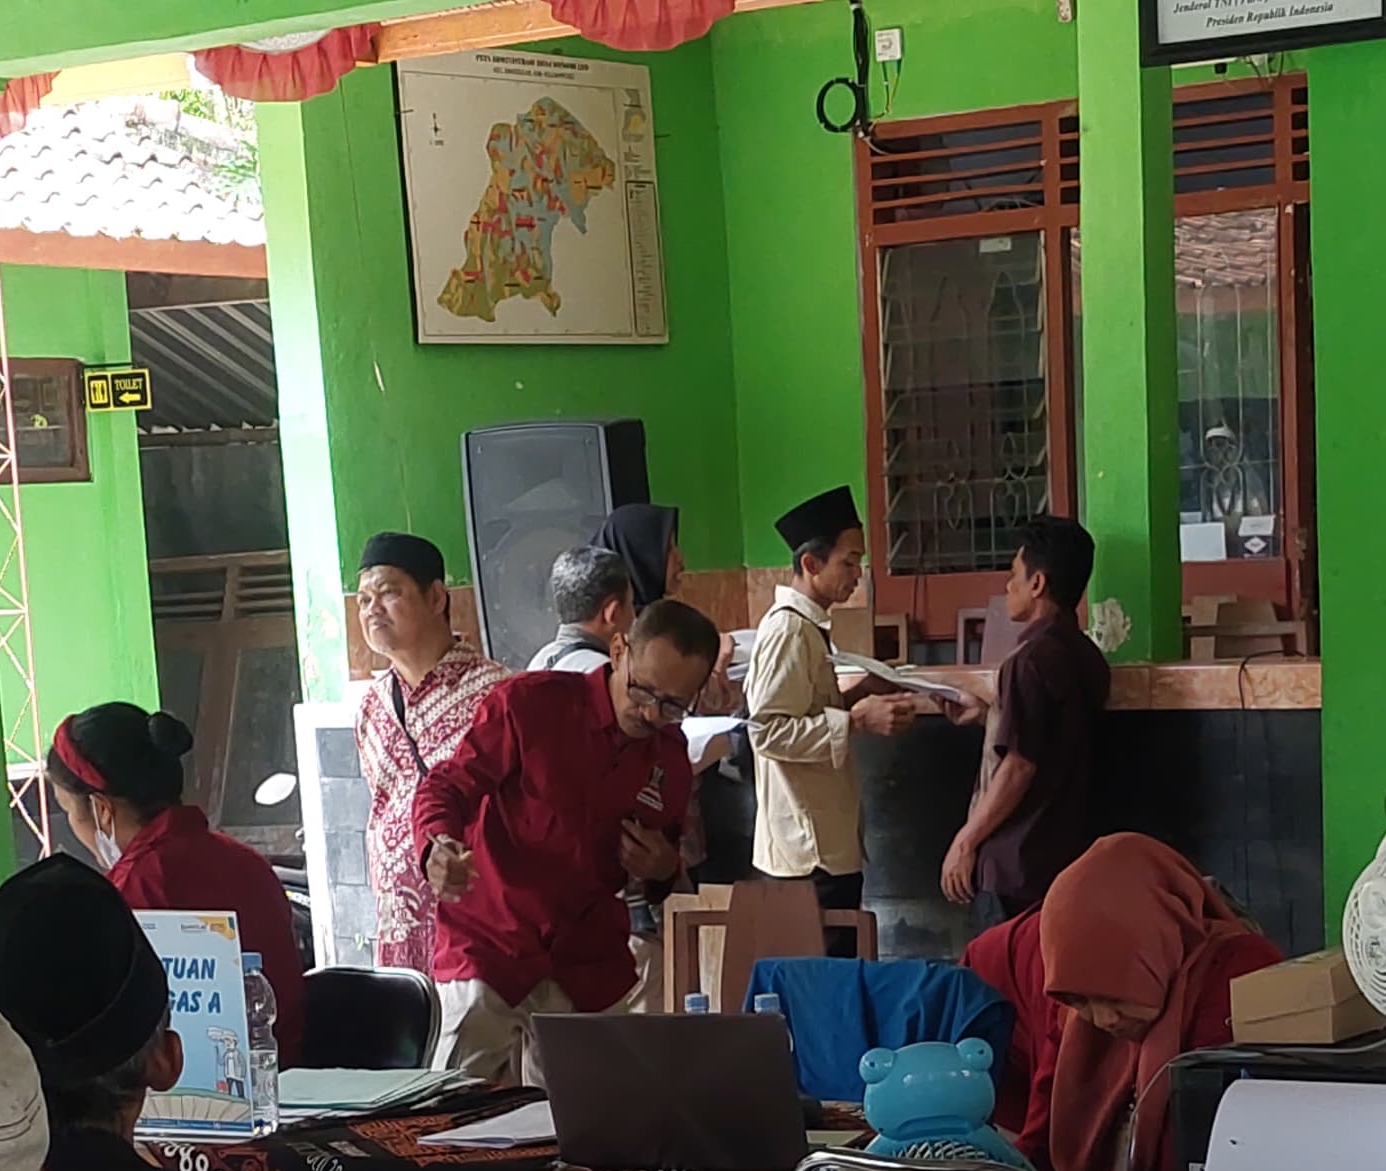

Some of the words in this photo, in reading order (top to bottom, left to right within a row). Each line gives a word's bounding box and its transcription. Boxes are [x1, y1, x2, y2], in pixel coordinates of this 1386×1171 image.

[1205, 13, 1244, 28] Presiden
[1246, 7, 1286, 24] Republik
[1289, 2, 1334, 17] Indonesia
[114, 377, 143, 391] TOILET
[161, 956, 216, 981] TUAN
[207, 991, 222, 1014] A
